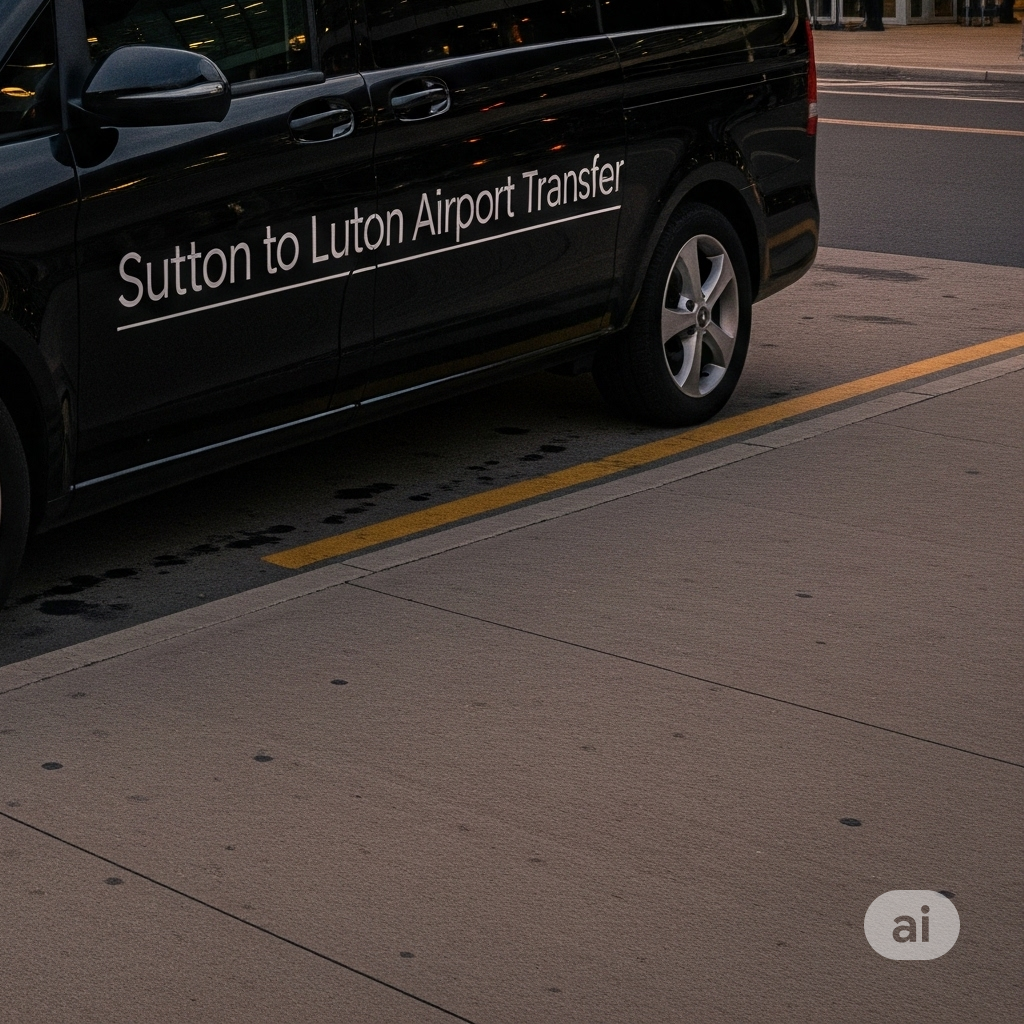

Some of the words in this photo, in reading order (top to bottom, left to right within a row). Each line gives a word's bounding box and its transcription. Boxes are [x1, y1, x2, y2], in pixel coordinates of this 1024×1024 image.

[118, 241, 252, 308] Sutton
[263, 225, 300, 274] to
[311, 206, 405, 264] Luton
[412, 176, 516, 243] Airport
[522, 153, 625, 214] Transfer
